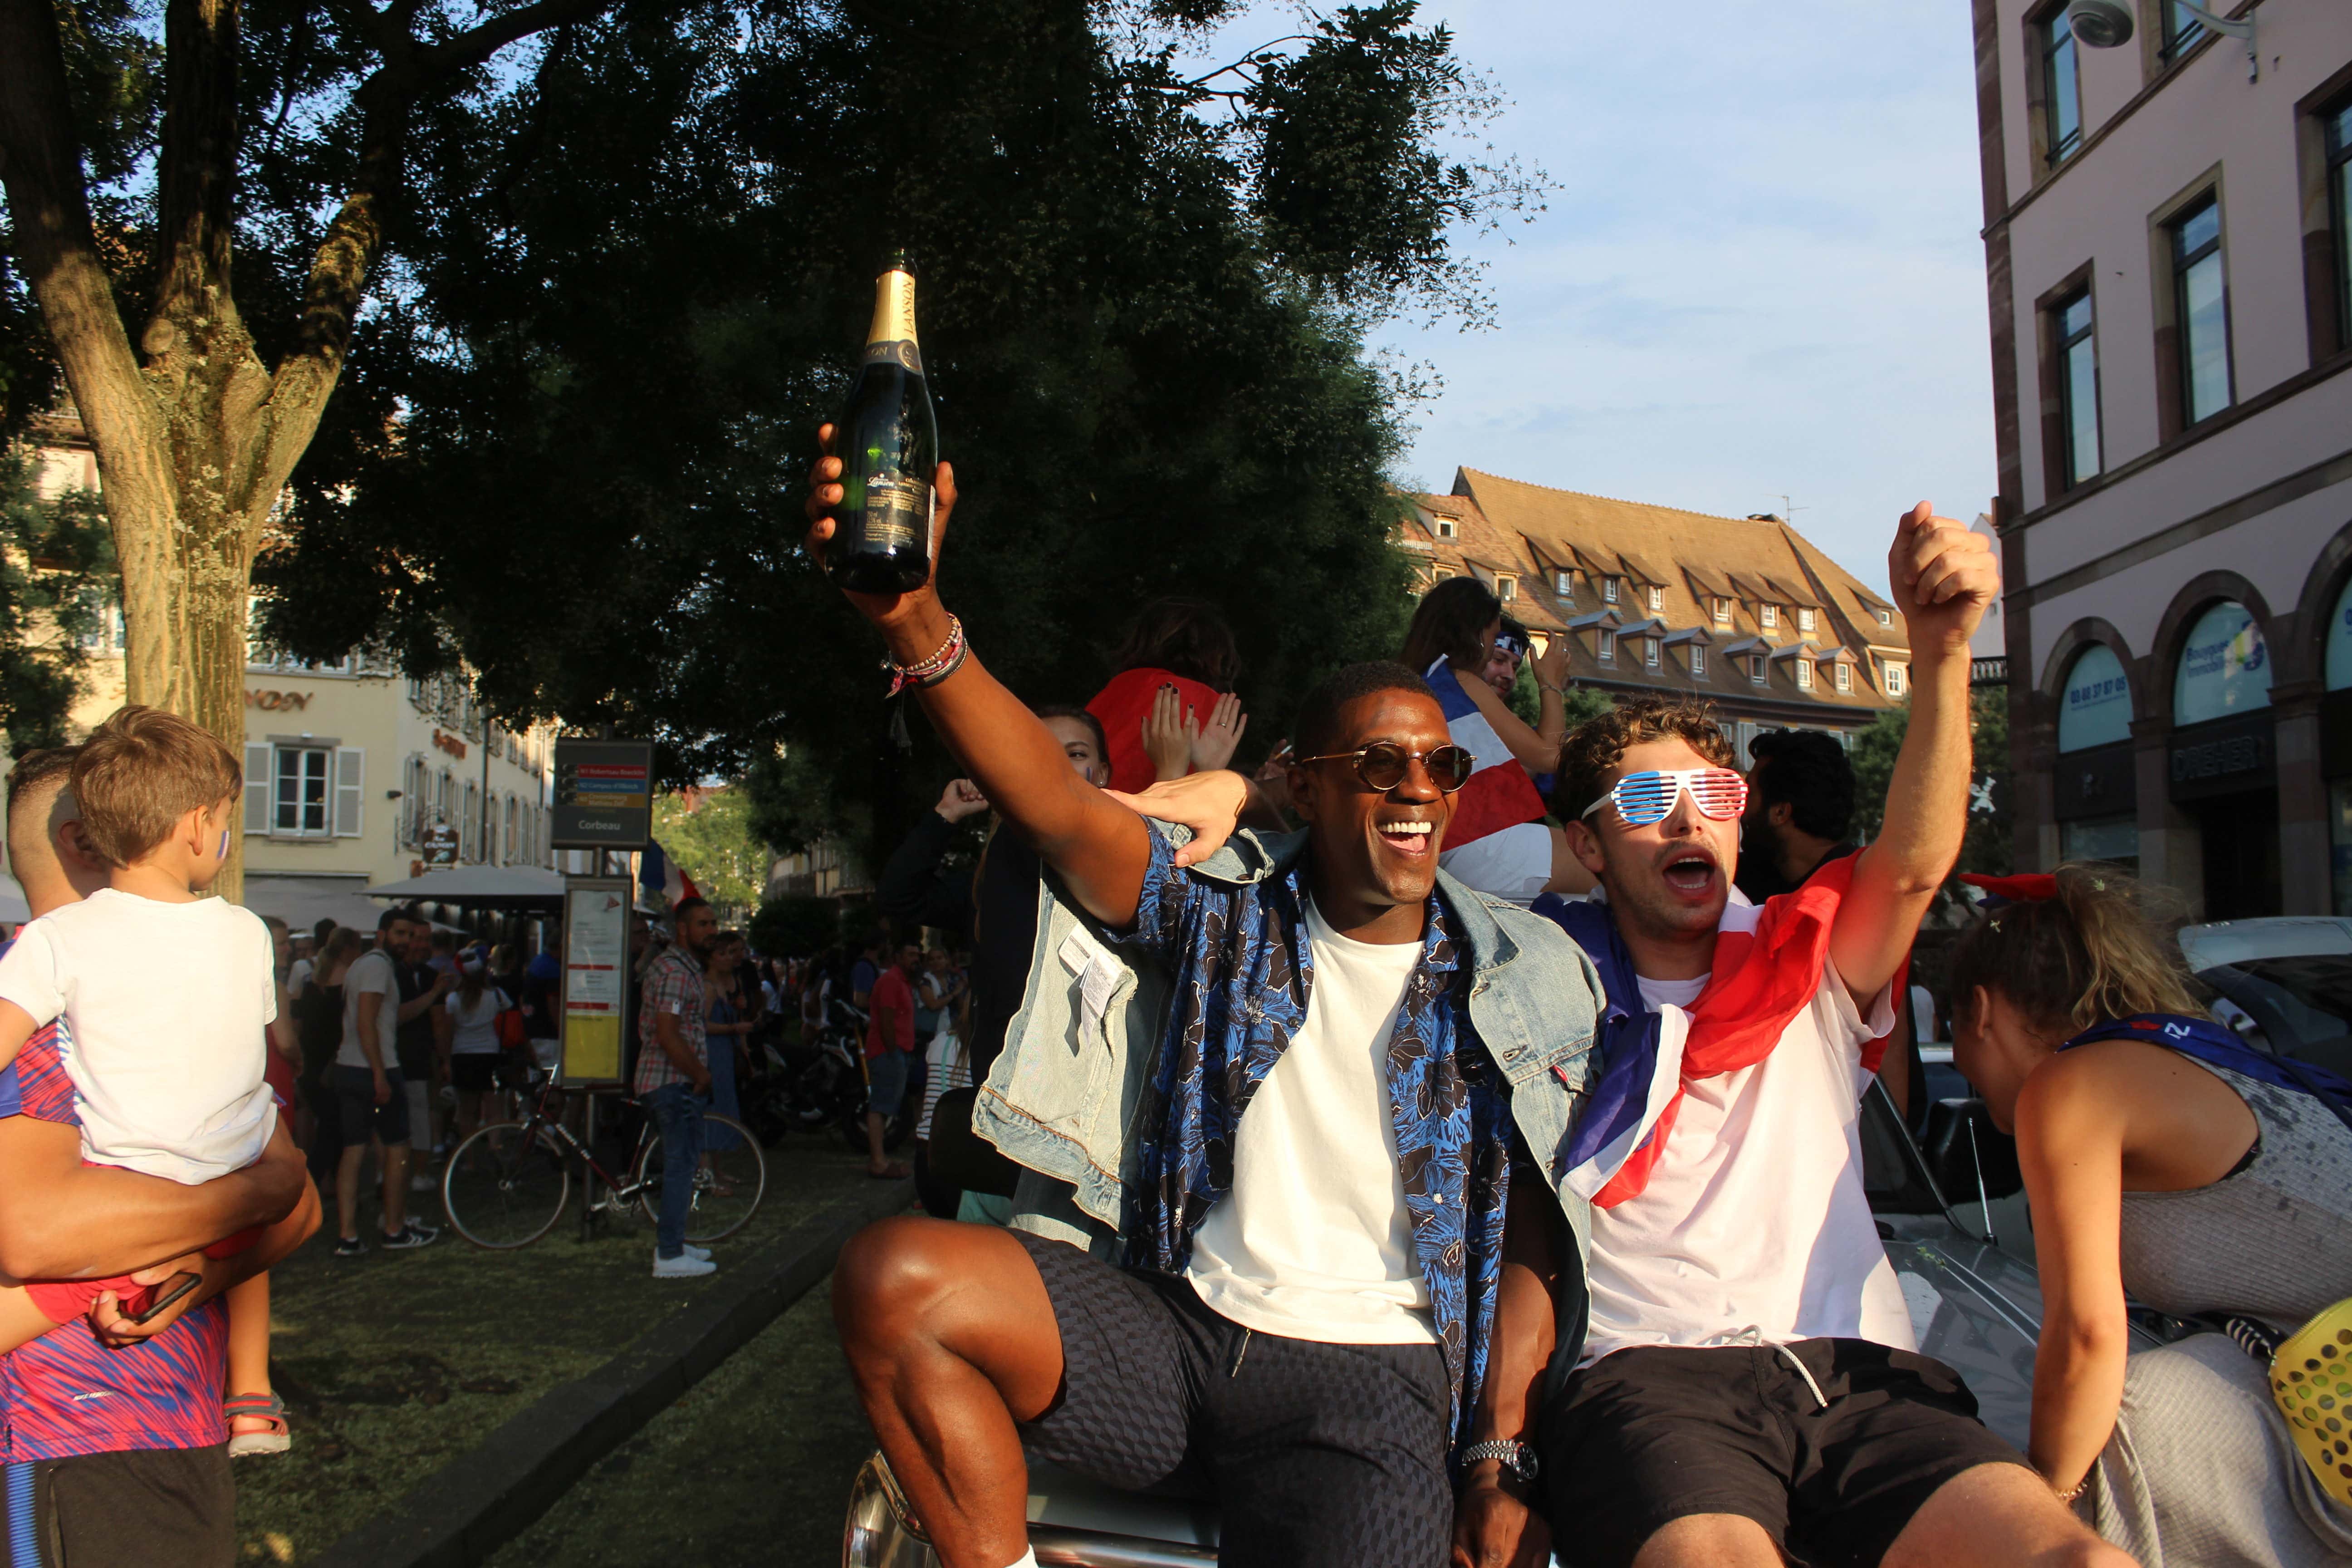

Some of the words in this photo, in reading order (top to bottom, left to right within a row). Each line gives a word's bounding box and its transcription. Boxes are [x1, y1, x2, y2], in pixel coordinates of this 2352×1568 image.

[902, 279, 913, 334] LANSON
[867, 477, 894, 487] Lanson
[578, 820, 621, 830] Corbeau
